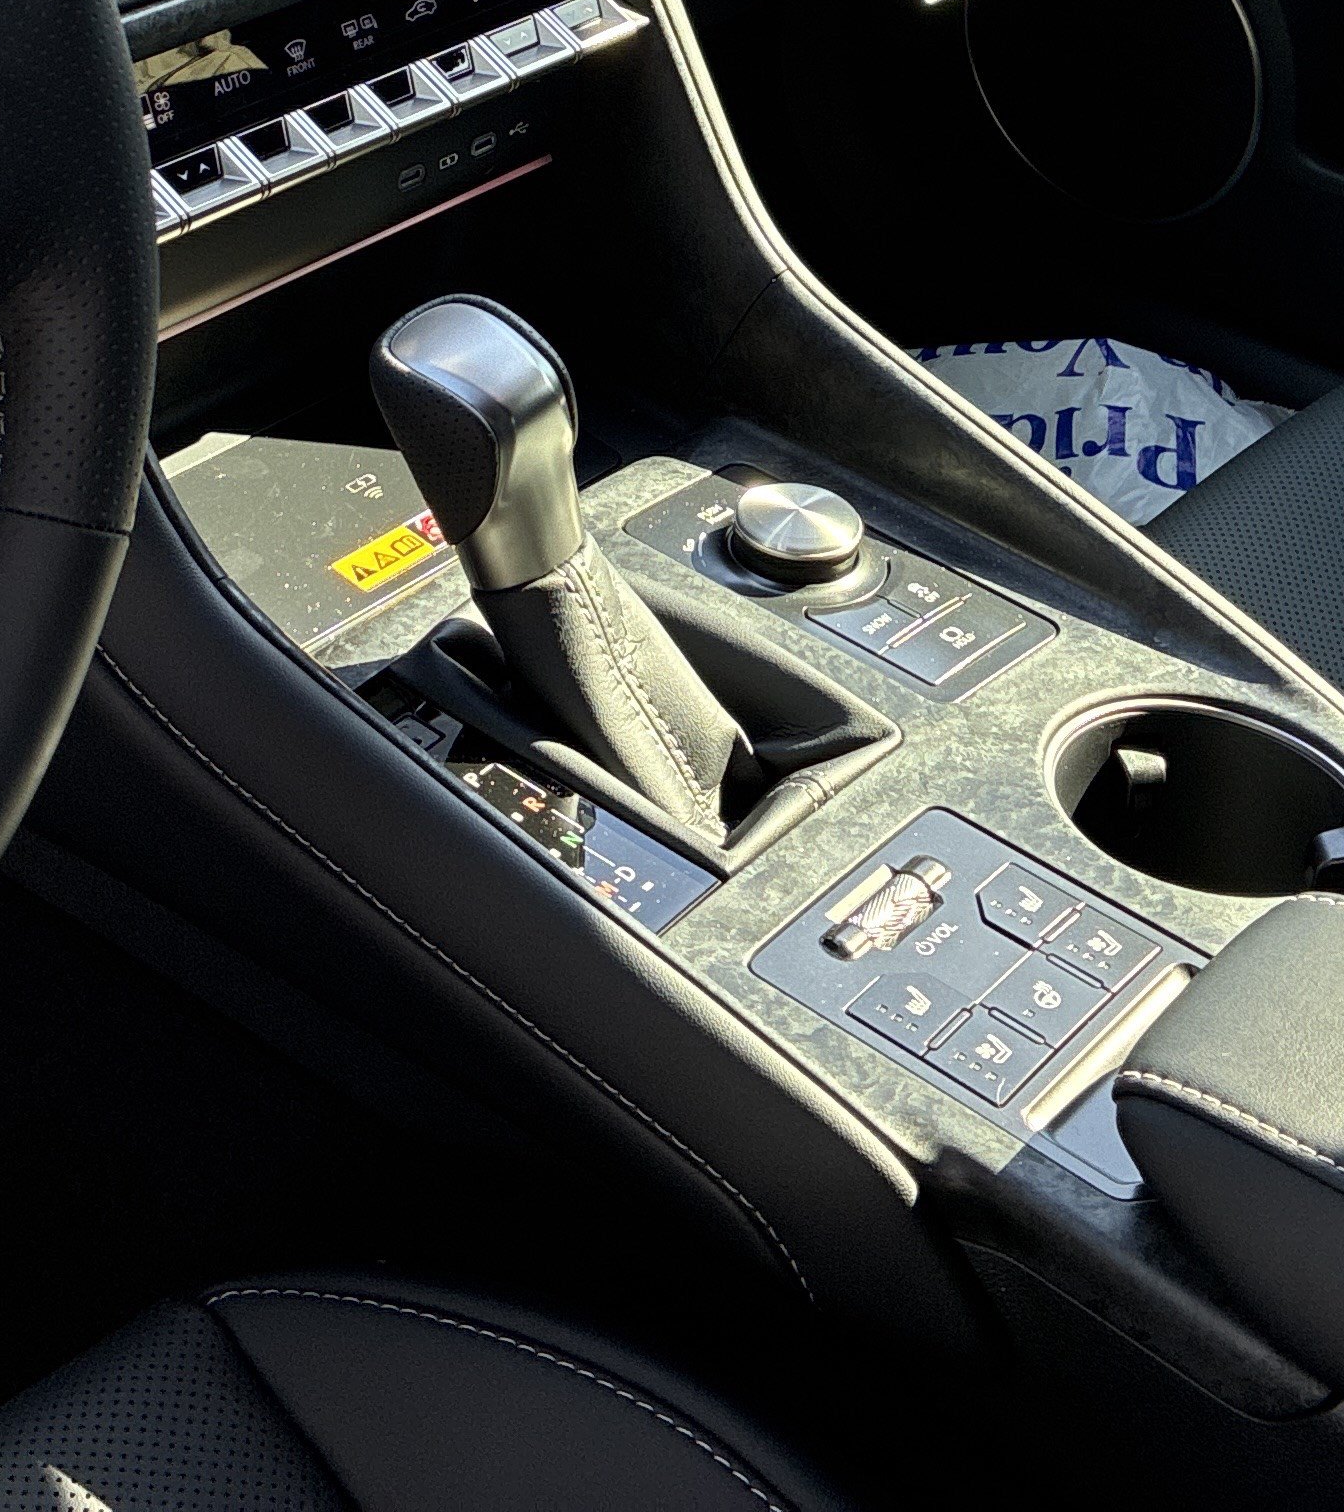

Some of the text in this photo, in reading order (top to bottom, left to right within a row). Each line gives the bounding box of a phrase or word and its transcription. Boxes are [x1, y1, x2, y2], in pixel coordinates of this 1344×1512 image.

[352, 34, 375, 50] REAR
[286, 56, 316, 78] FRONT
[212, 70, 252, 98] AUTO
[156, 109, 175, 125] OFF
[462, 771, 482, 789] P
[521, 795, 546, 813] R
[560, 830, 584, 849] N
[613, 866, 637, 883] D
[928, 921, 960, 946] VOL
